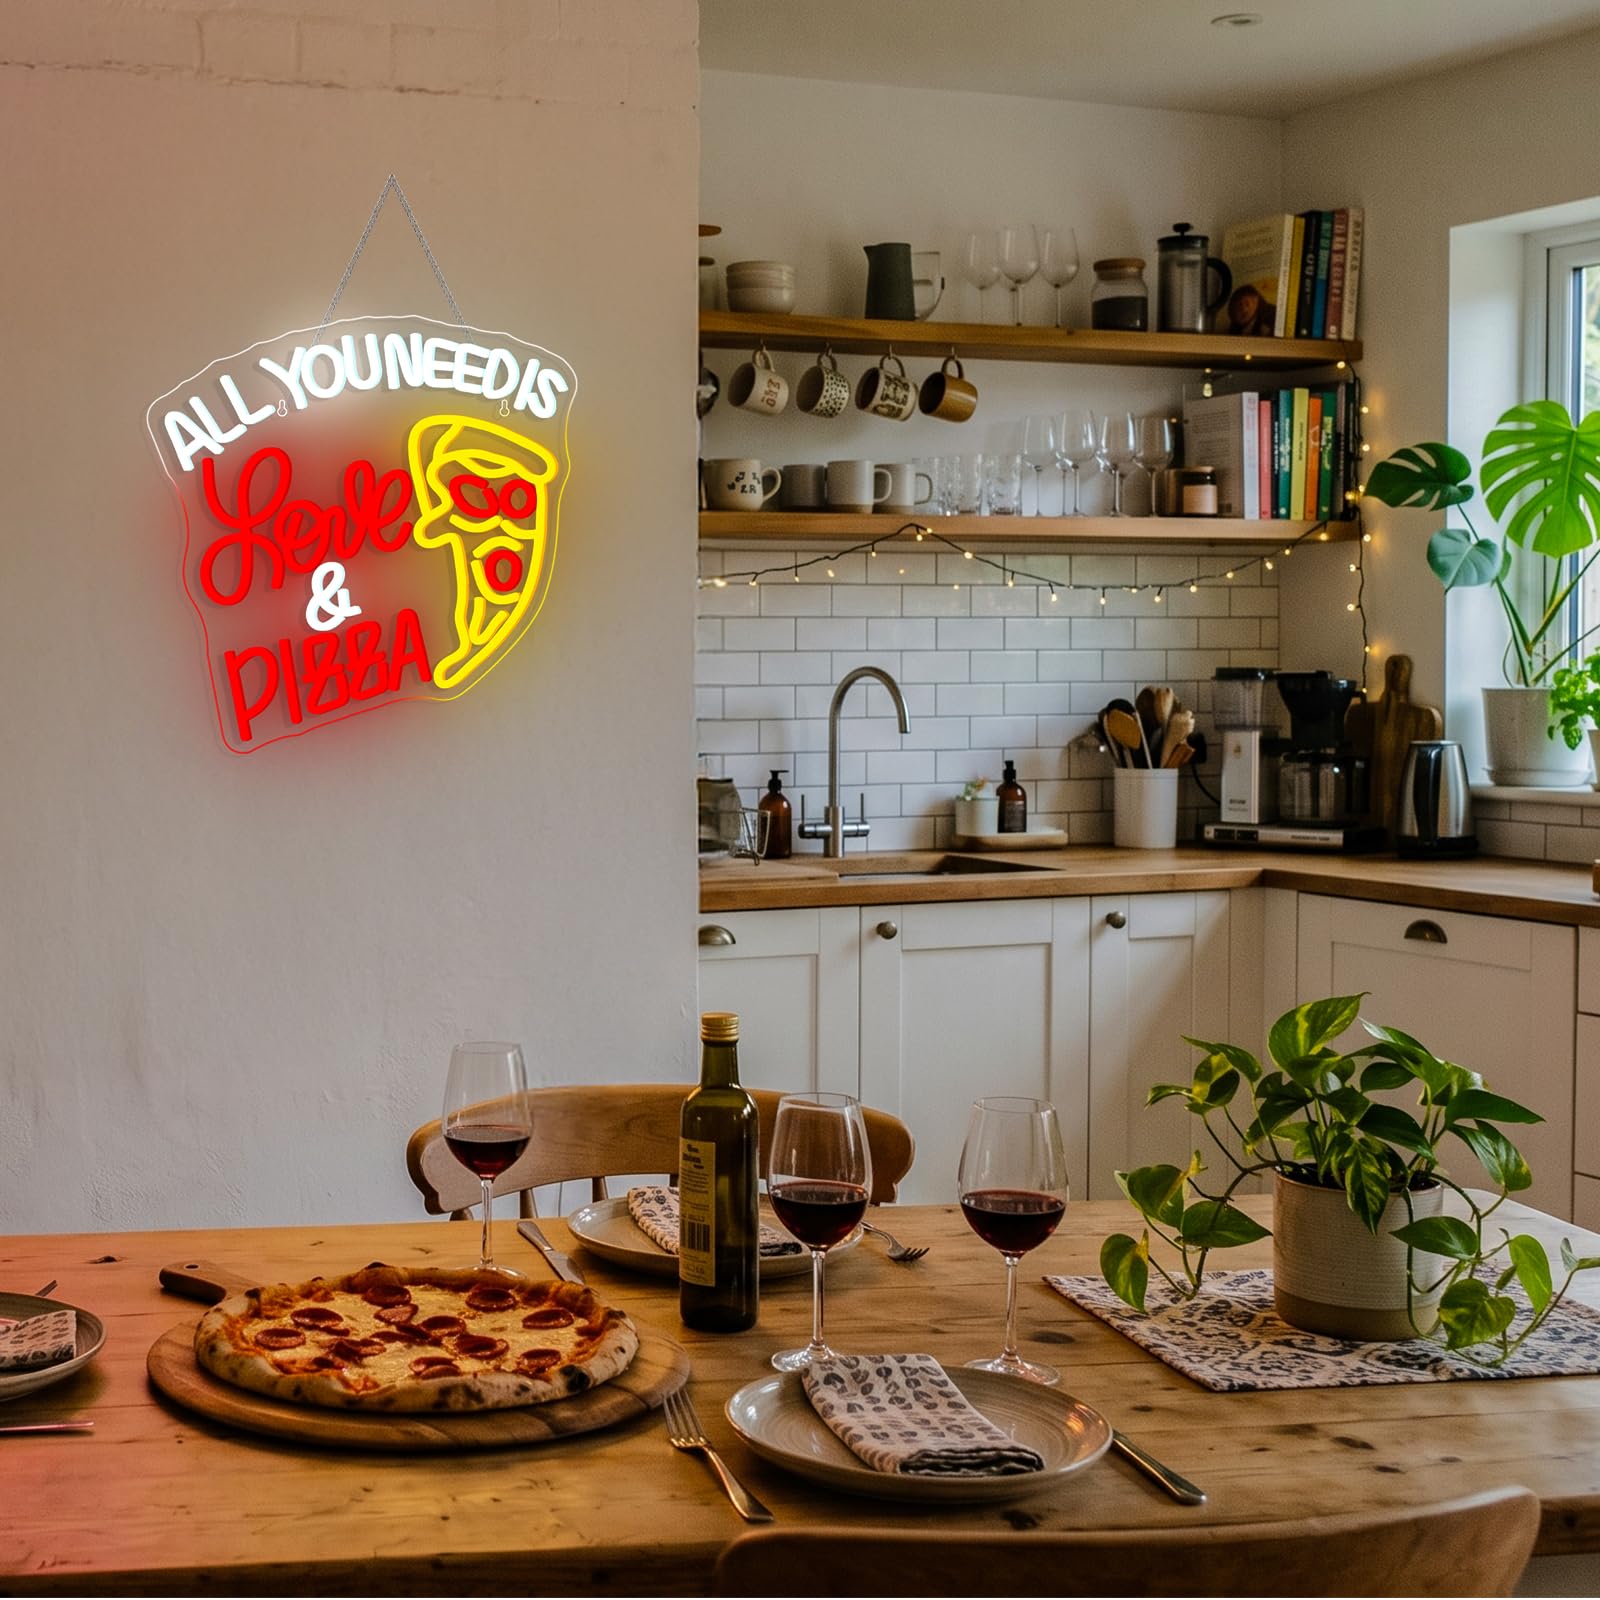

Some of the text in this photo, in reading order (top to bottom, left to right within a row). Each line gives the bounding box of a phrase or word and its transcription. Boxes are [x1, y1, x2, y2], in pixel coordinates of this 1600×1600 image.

[164, 332, 569, 471] ALL YOU NEED IS
[200, 447, 412, 605] Love
[305, 561, 361, 631] &
